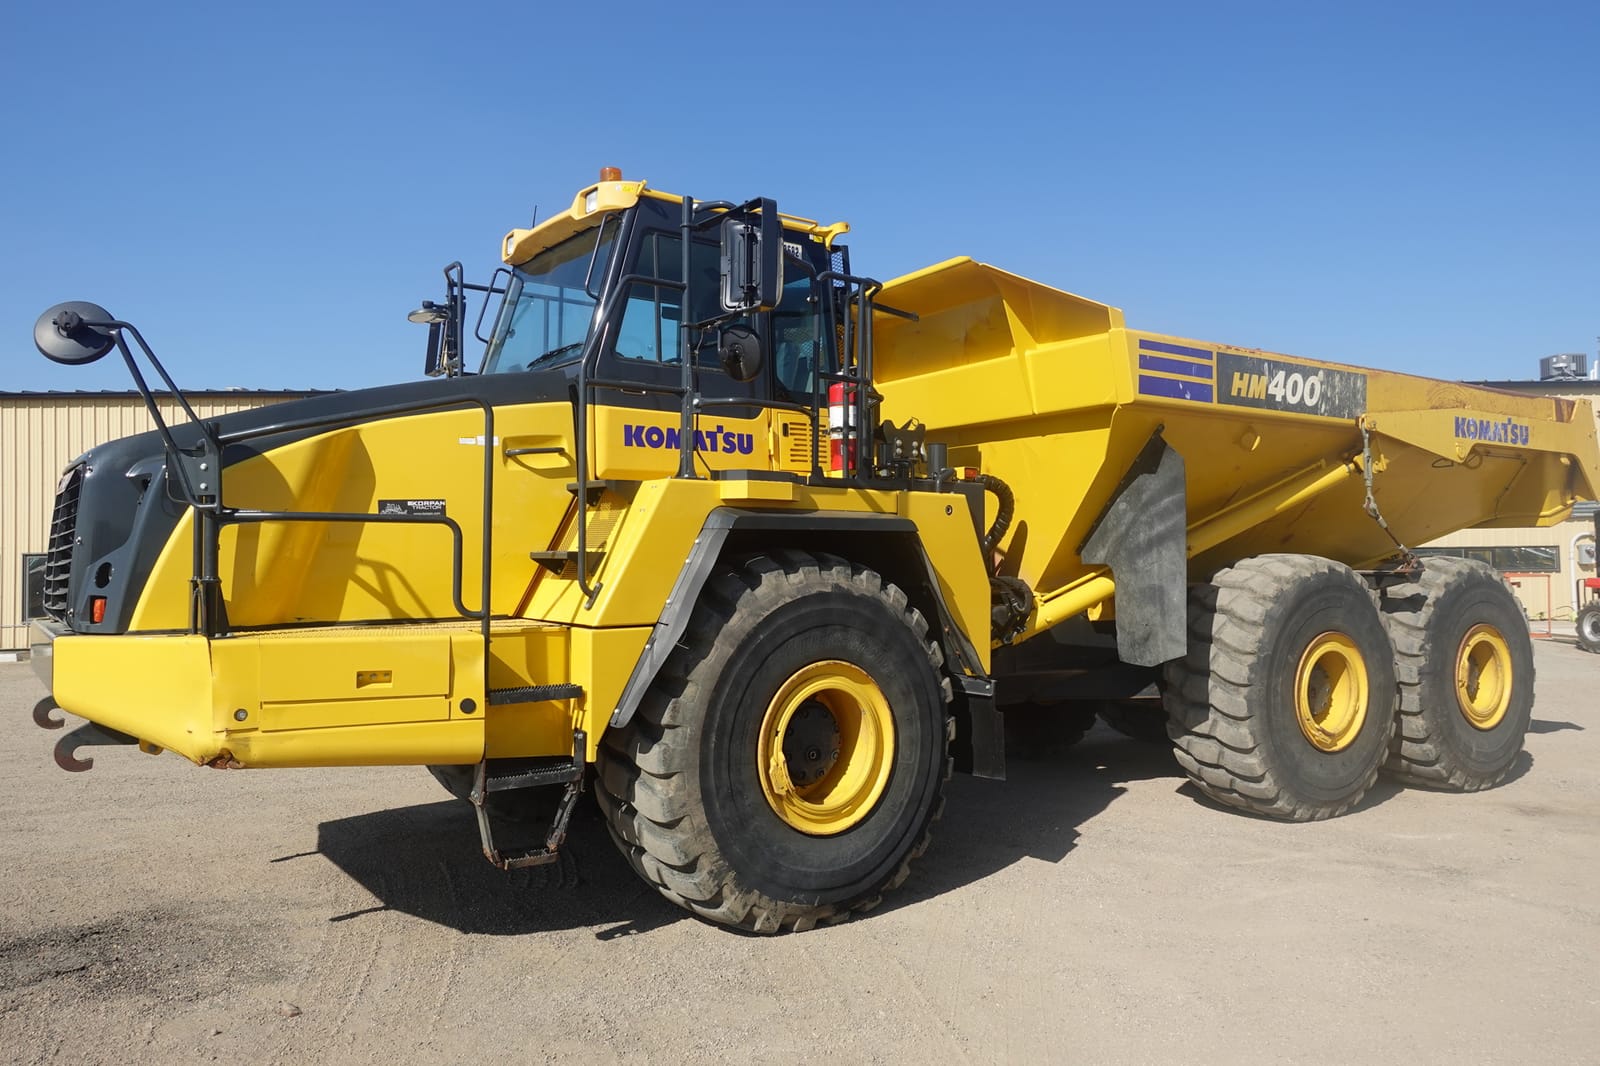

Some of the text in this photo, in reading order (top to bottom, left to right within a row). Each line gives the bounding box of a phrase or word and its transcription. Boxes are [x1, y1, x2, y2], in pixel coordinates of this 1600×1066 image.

[1231, 370, 1321, 407] HM400
[624, 424, 753, 455] KOMATSU
[1454, 416, 1529, 446] KOMATSU
